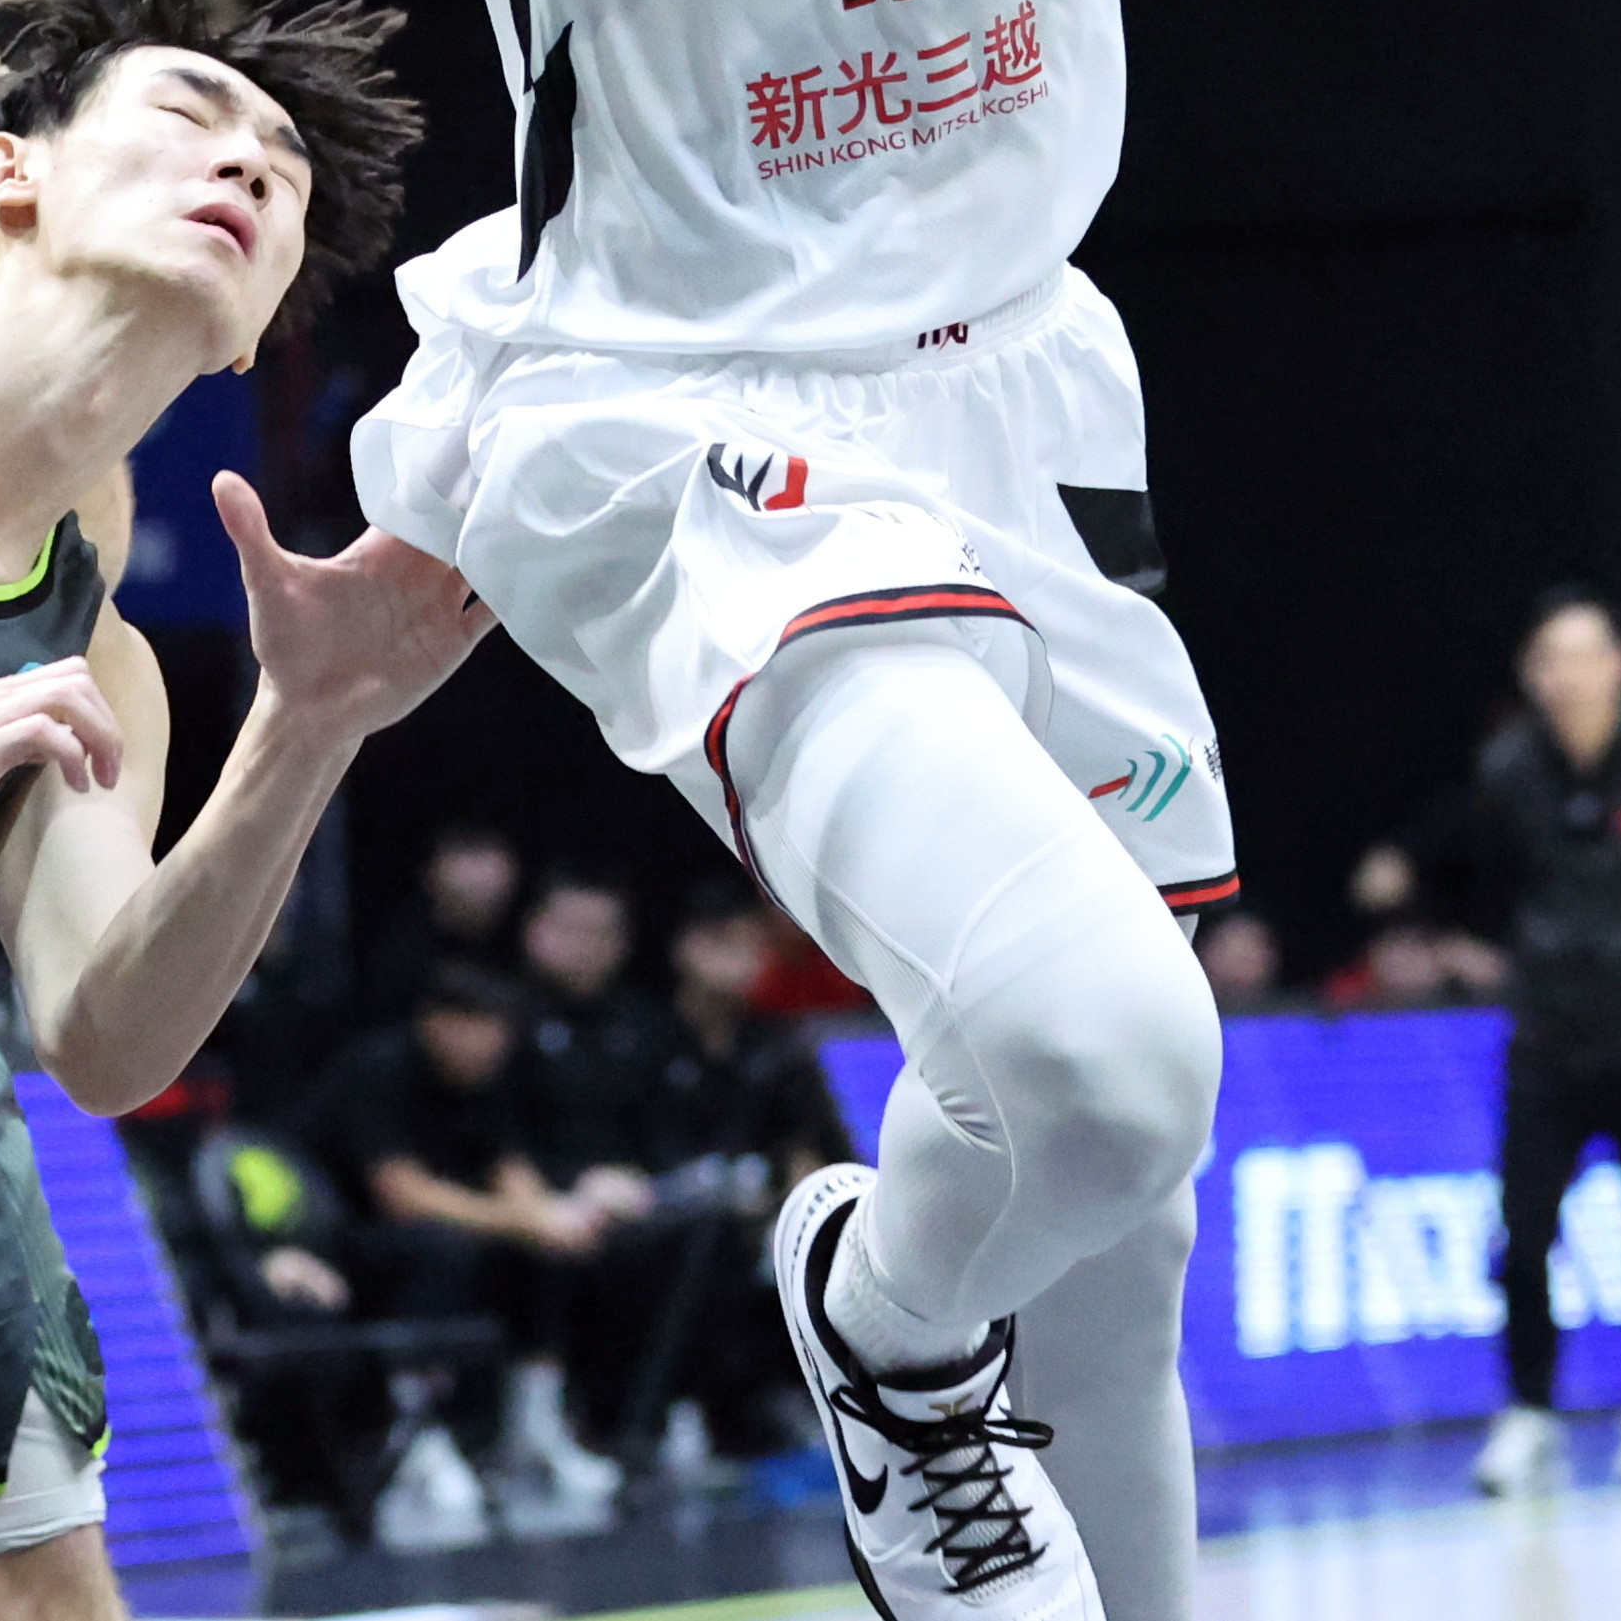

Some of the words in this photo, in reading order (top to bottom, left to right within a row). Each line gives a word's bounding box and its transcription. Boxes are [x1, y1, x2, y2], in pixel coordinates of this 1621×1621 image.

[745, 0, 1043, 150] 新光三越
[757, 150, 825, 181] SHIN
[830, 130, 907, 166] KONG
[911, 80, 1050, 148] MITSUKOSHI
